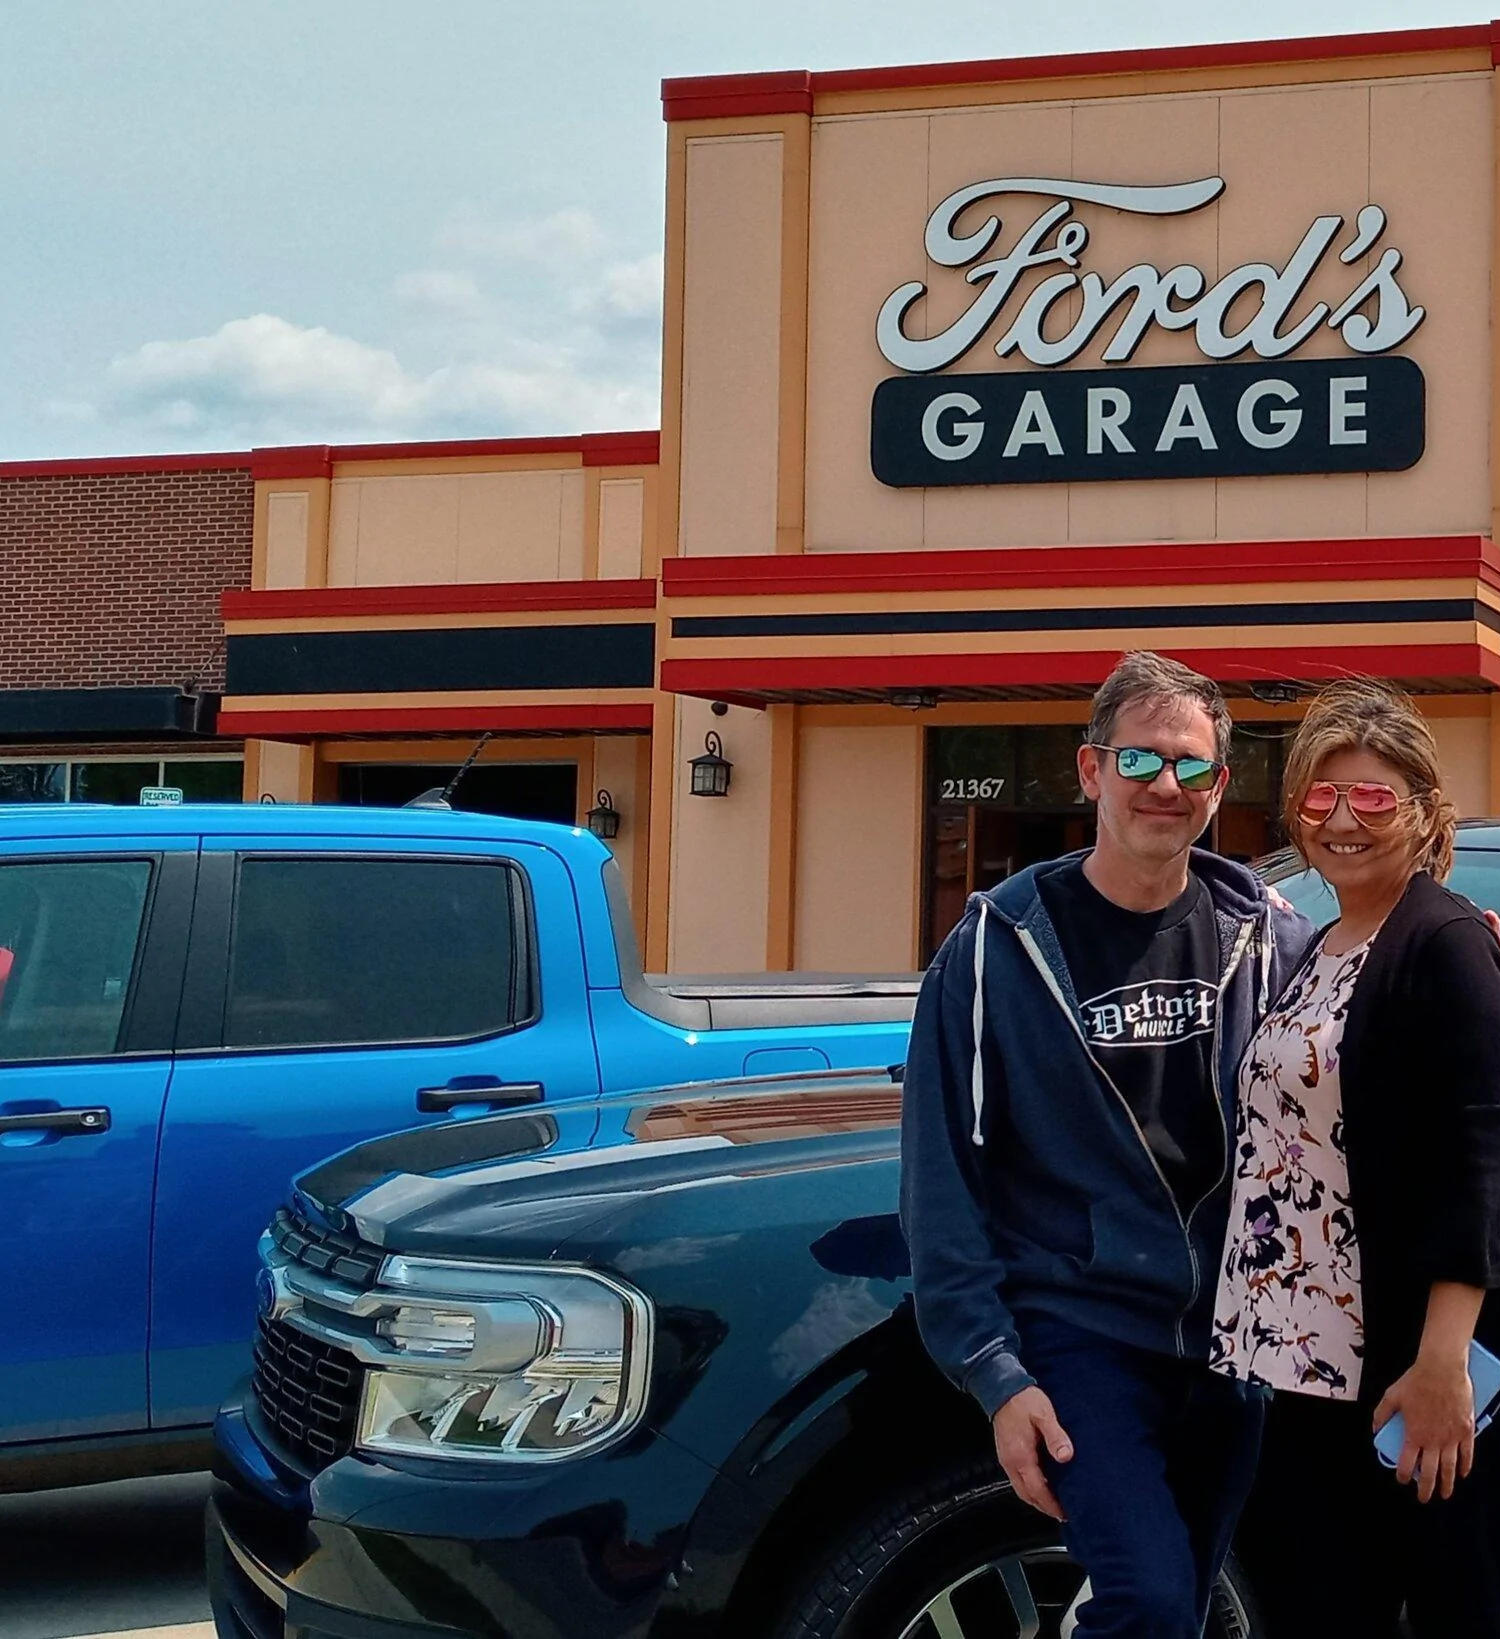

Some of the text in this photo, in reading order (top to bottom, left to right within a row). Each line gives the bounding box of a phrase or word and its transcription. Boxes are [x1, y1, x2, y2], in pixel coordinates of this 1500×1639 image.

[876, 176, 1425, 373] Ford's
[921, 375, 1368, 461] GARAGE
[143, 792, 179, 800] RESERVED
[941, 777, 1005, 799] 21367
[1088, 987, 1215, 1040] Detroit
